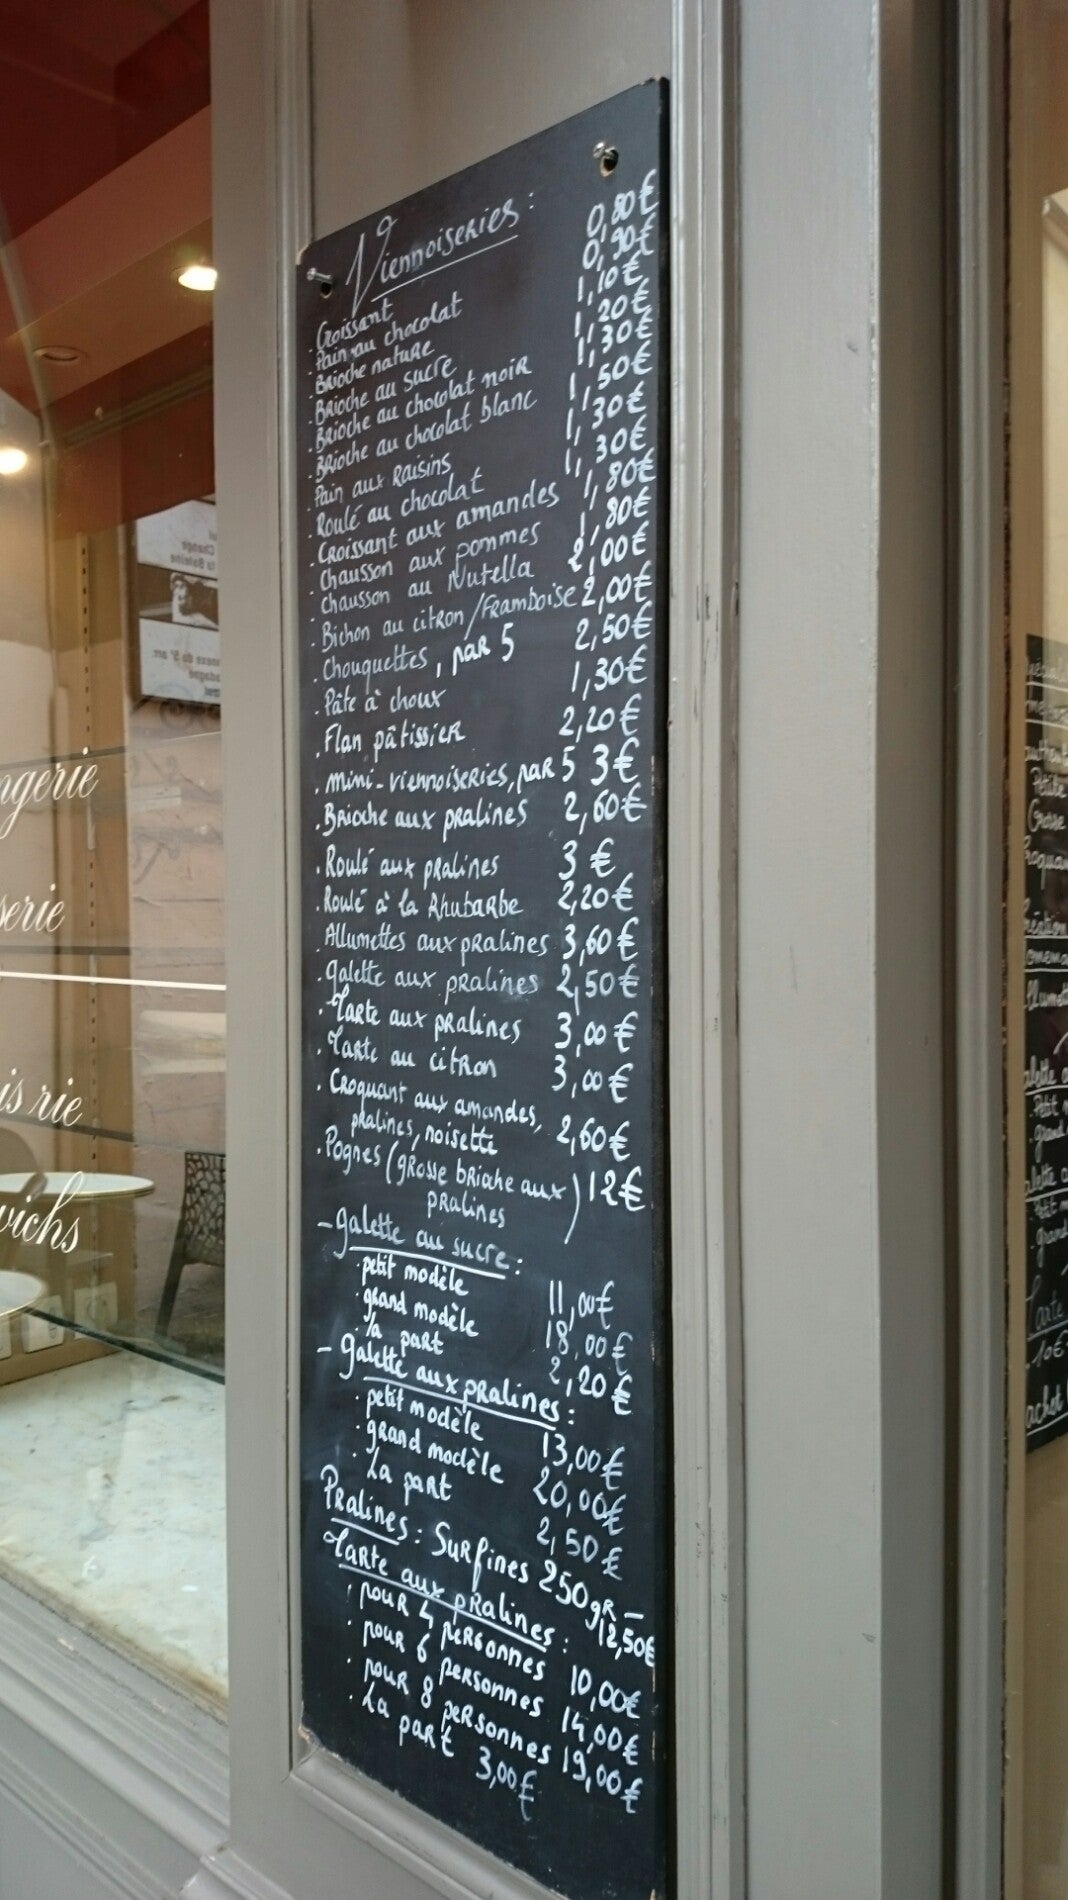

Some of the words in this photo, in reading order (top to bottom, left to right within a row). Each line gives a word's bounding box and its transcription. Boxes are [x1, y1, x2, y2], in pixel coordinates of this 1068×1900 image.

[501, 622, 515, 662] 5
[562, 746, 576, 782] 5
[419, 1599, 434, 1630] 4
[417, 1633, 430, 1663] 6
[420, 1675, 434, 1709] 8
